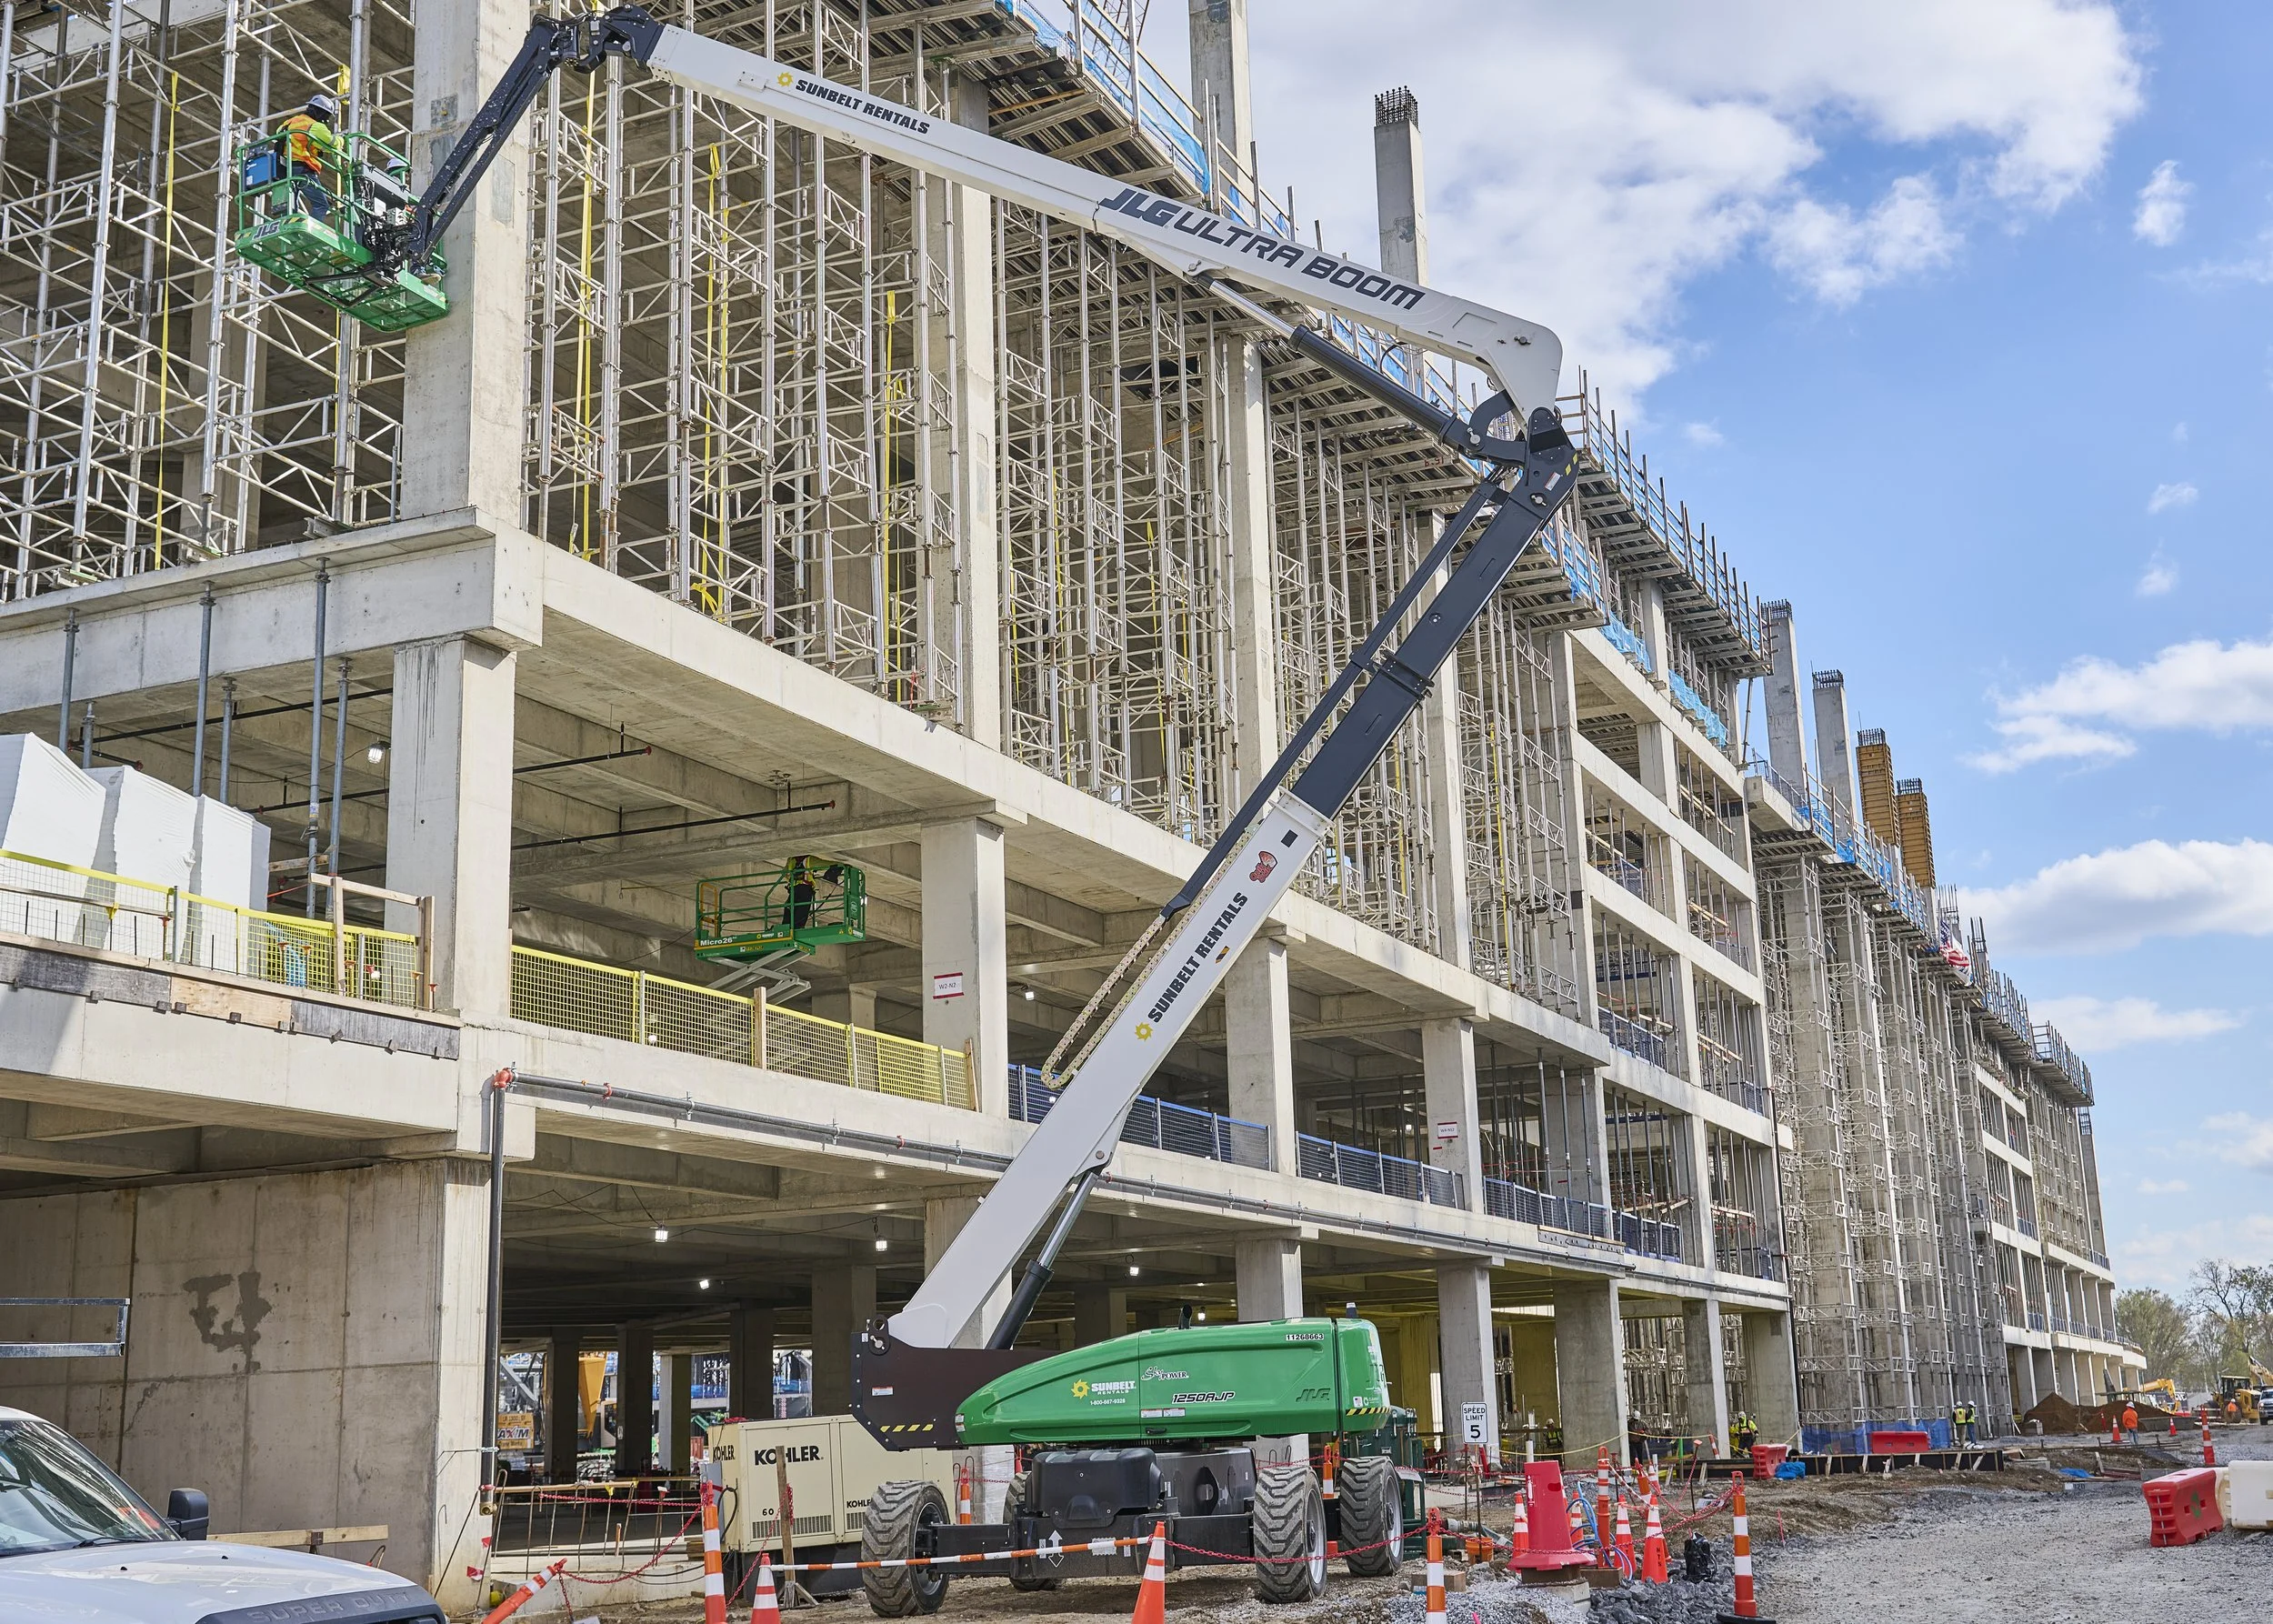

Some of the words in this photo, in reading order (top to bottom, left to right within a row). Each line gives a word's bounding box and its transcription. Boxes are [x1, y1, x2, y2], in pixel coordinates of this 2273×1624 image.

[796, 78, 863, 111] SUNBELT
[862, 101, 931, 135] RENTALS
[253, 221, 279, 239] JLG
[1099, 187, 1183, 227] JLG
[1173, 211, 1304, 268] ULTRA
[1300, 254, 1427, 311] BOOM
[700, 936, 734, 947] Micro26
[1147, 955, 1201, 1023] SUNBELT
[1194, 892, 1248, 959] RENTALS
[1091, 1380, 1136, 1392] SUNBELT
[1172, 1391, 1236, 1405] 1250AJP
[1295, 1388, 1331, 1402] JLG
[496, 1428, 530, 1439] AXIM
[1470, 1424, 1481, 1439] 5
[713, 1445, 736, 1461] KOHLER
[246, 1600, 344, 1622] SUPER
[354, 1591, 411, 1608] DUTY
